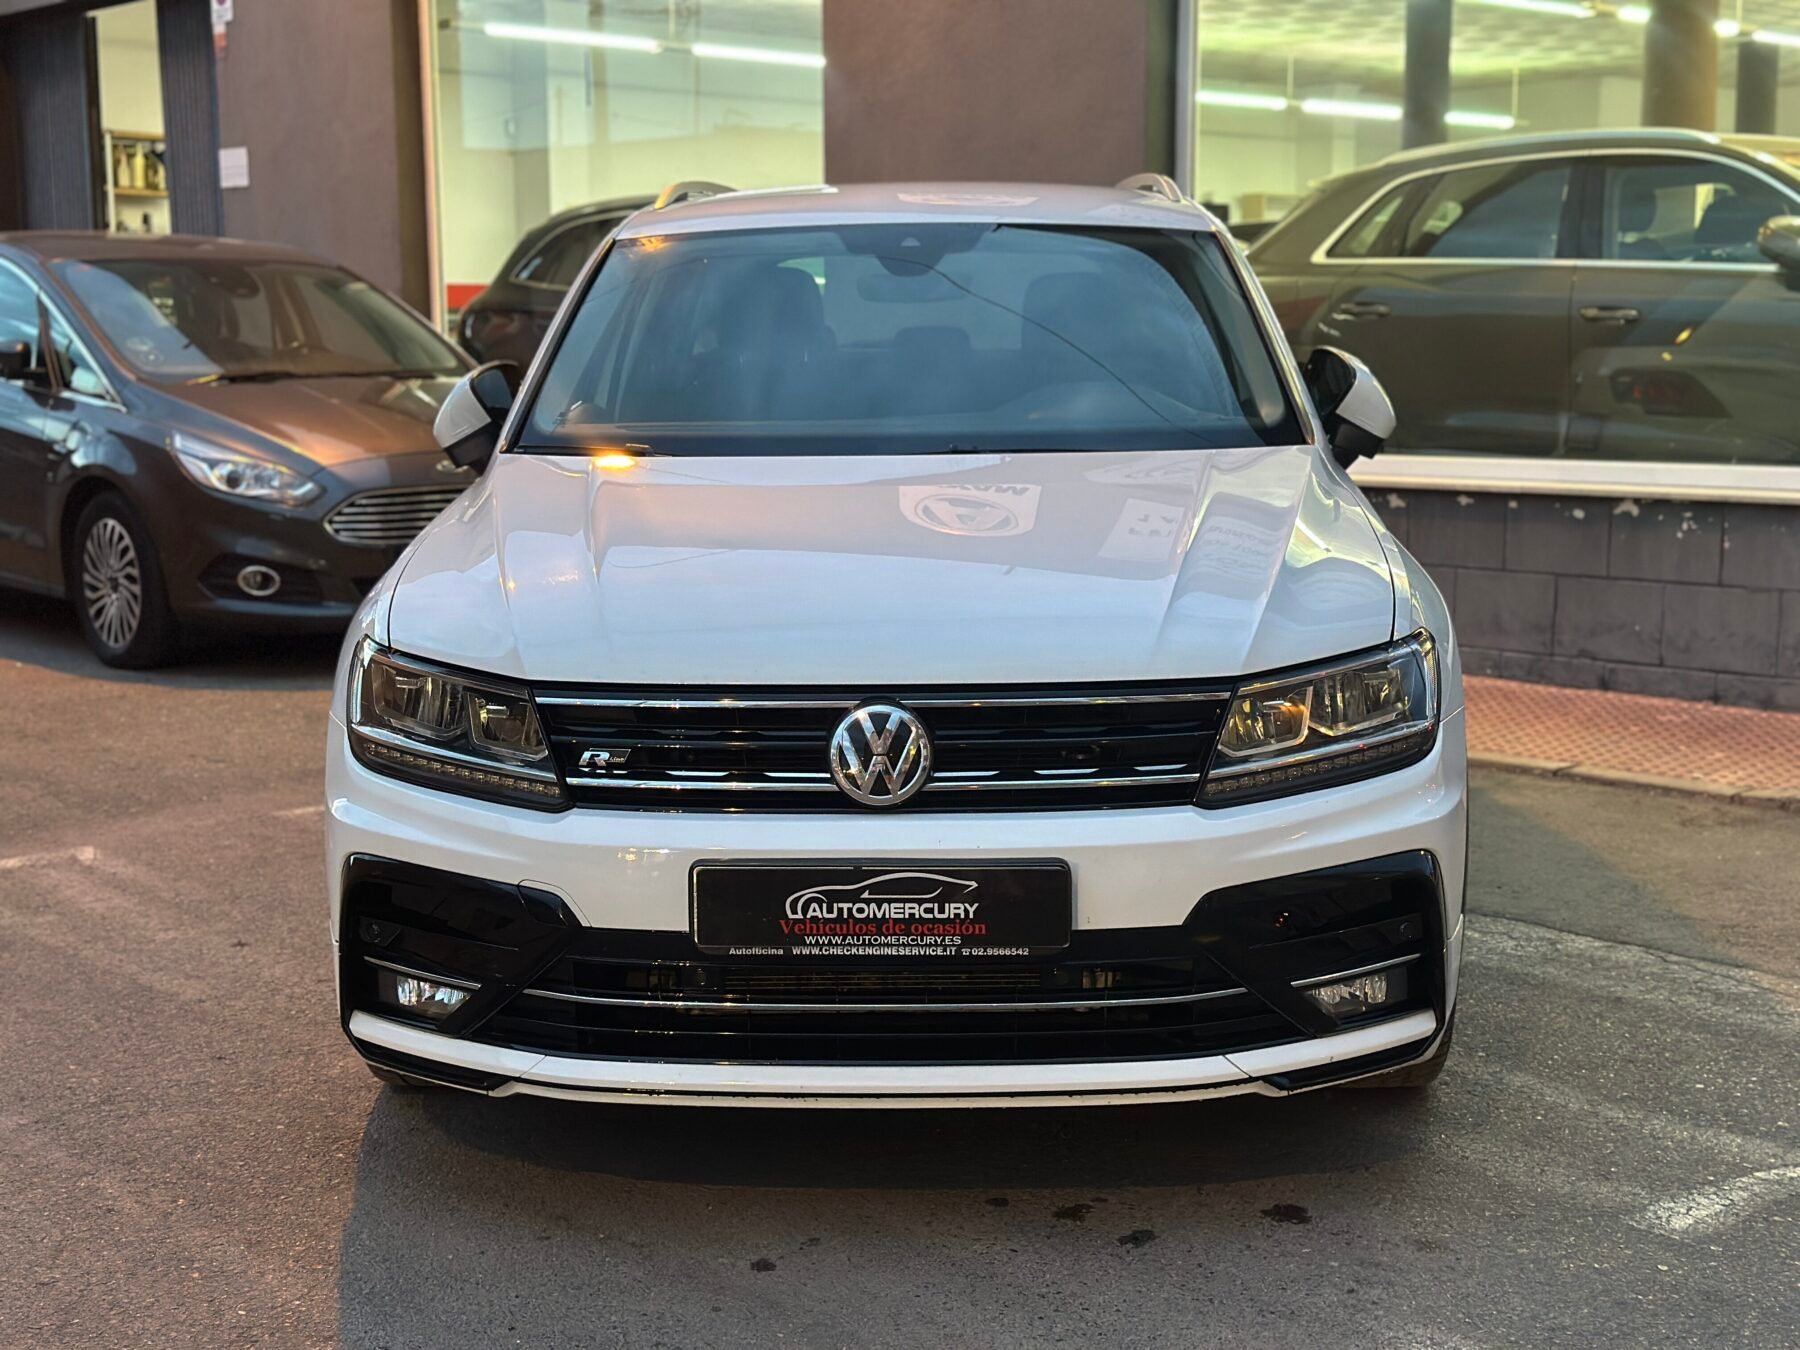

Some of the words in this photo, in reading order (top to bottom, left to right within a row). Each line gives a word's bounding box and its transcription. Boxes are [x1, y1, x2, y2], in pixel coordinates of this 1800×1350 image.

[578, 751, 610, 767] R
[806, 903, 979, 918] AUTOMERCURY
[779, 919, 877, 935] Vehículos
[883, 919, 905, 935] de
[911, 920, 986, 935] ocasión
[804, 936, 961, 945] WWW.AUTOMERCURY.ES
[792, 946, 957, 956] WWW.CHECKENGINESERVICE.IT
[972, 946, 1028, 956] 02.9566542
